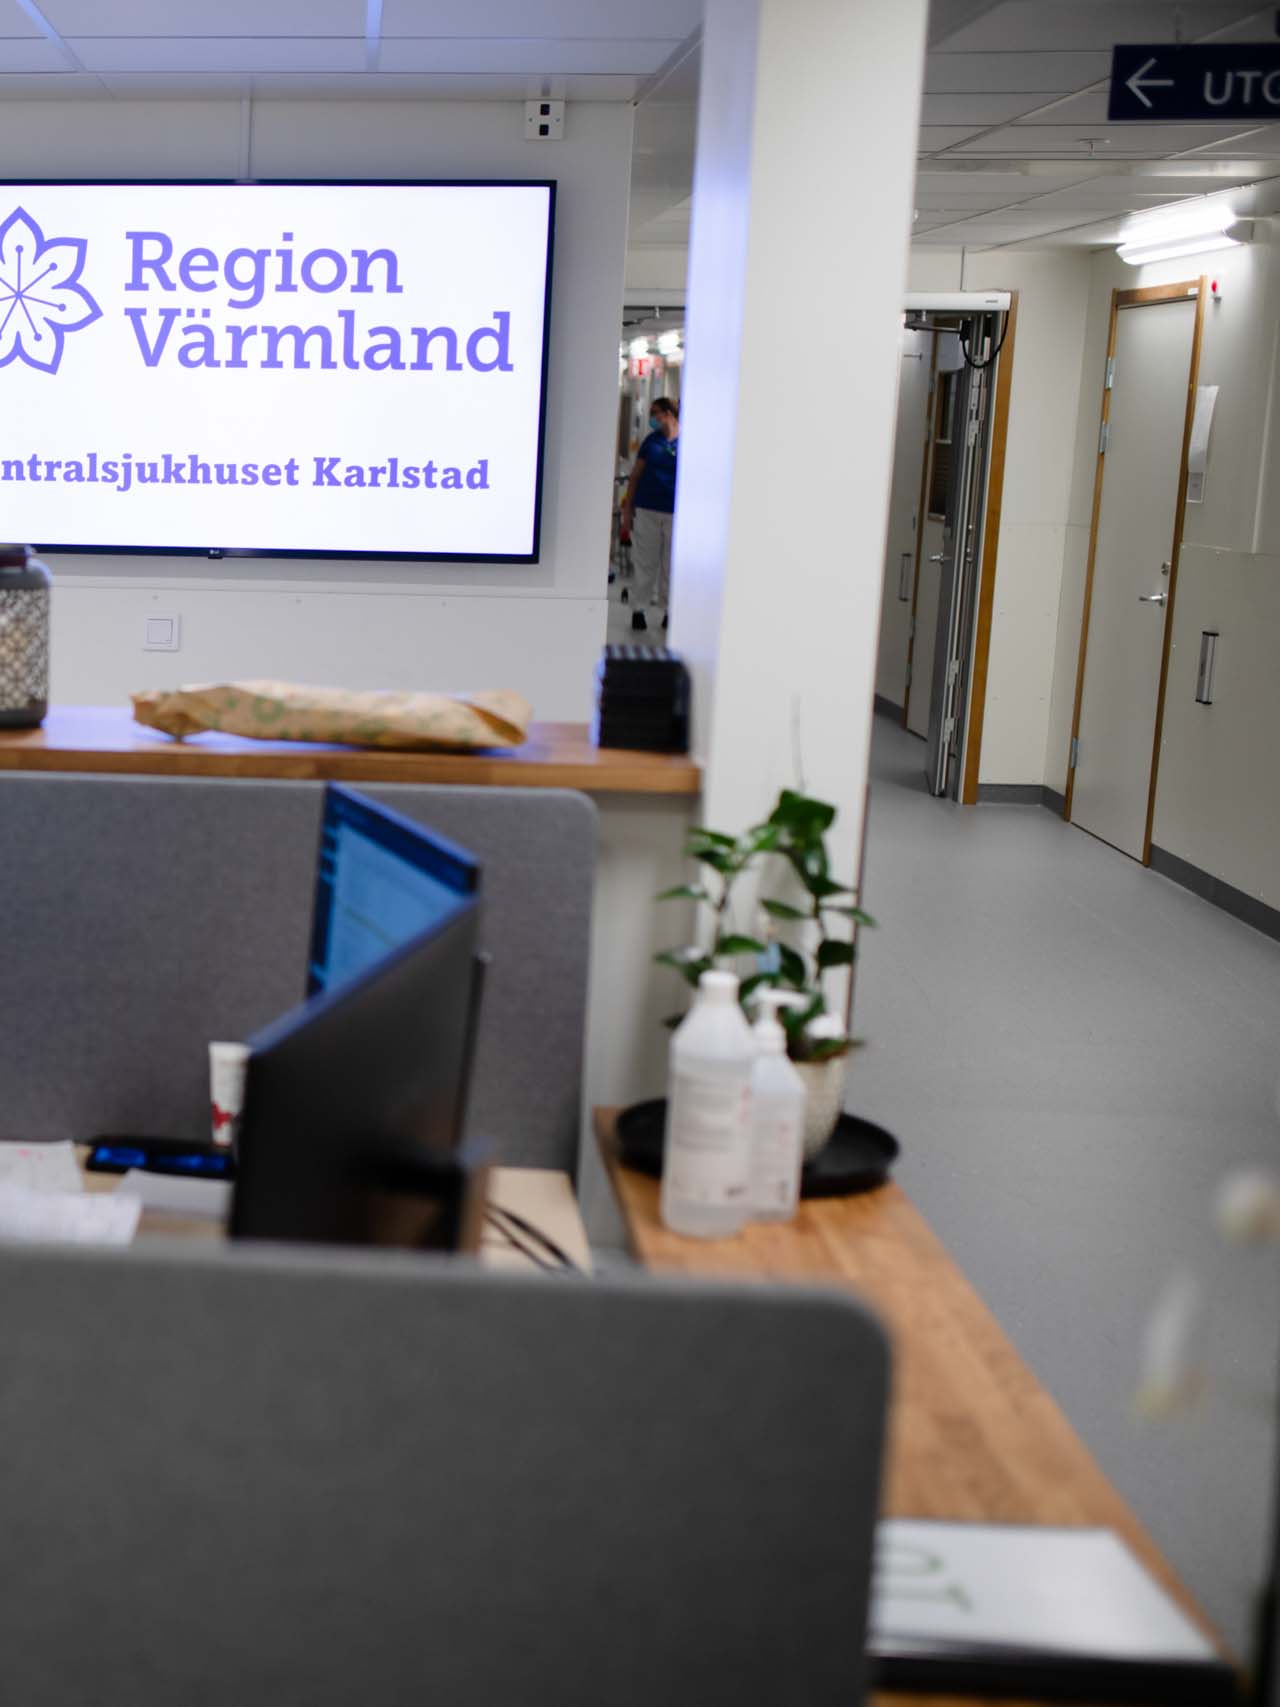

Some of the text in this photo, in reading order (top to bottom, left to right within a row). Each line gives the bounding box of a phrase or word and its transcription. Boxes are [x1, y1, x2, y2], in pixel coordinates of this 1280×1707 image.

[124, 231, 404, 310] Region
[123, 307, 514, 373] Värmland
[312, 456, 490, 490] Karlstad
